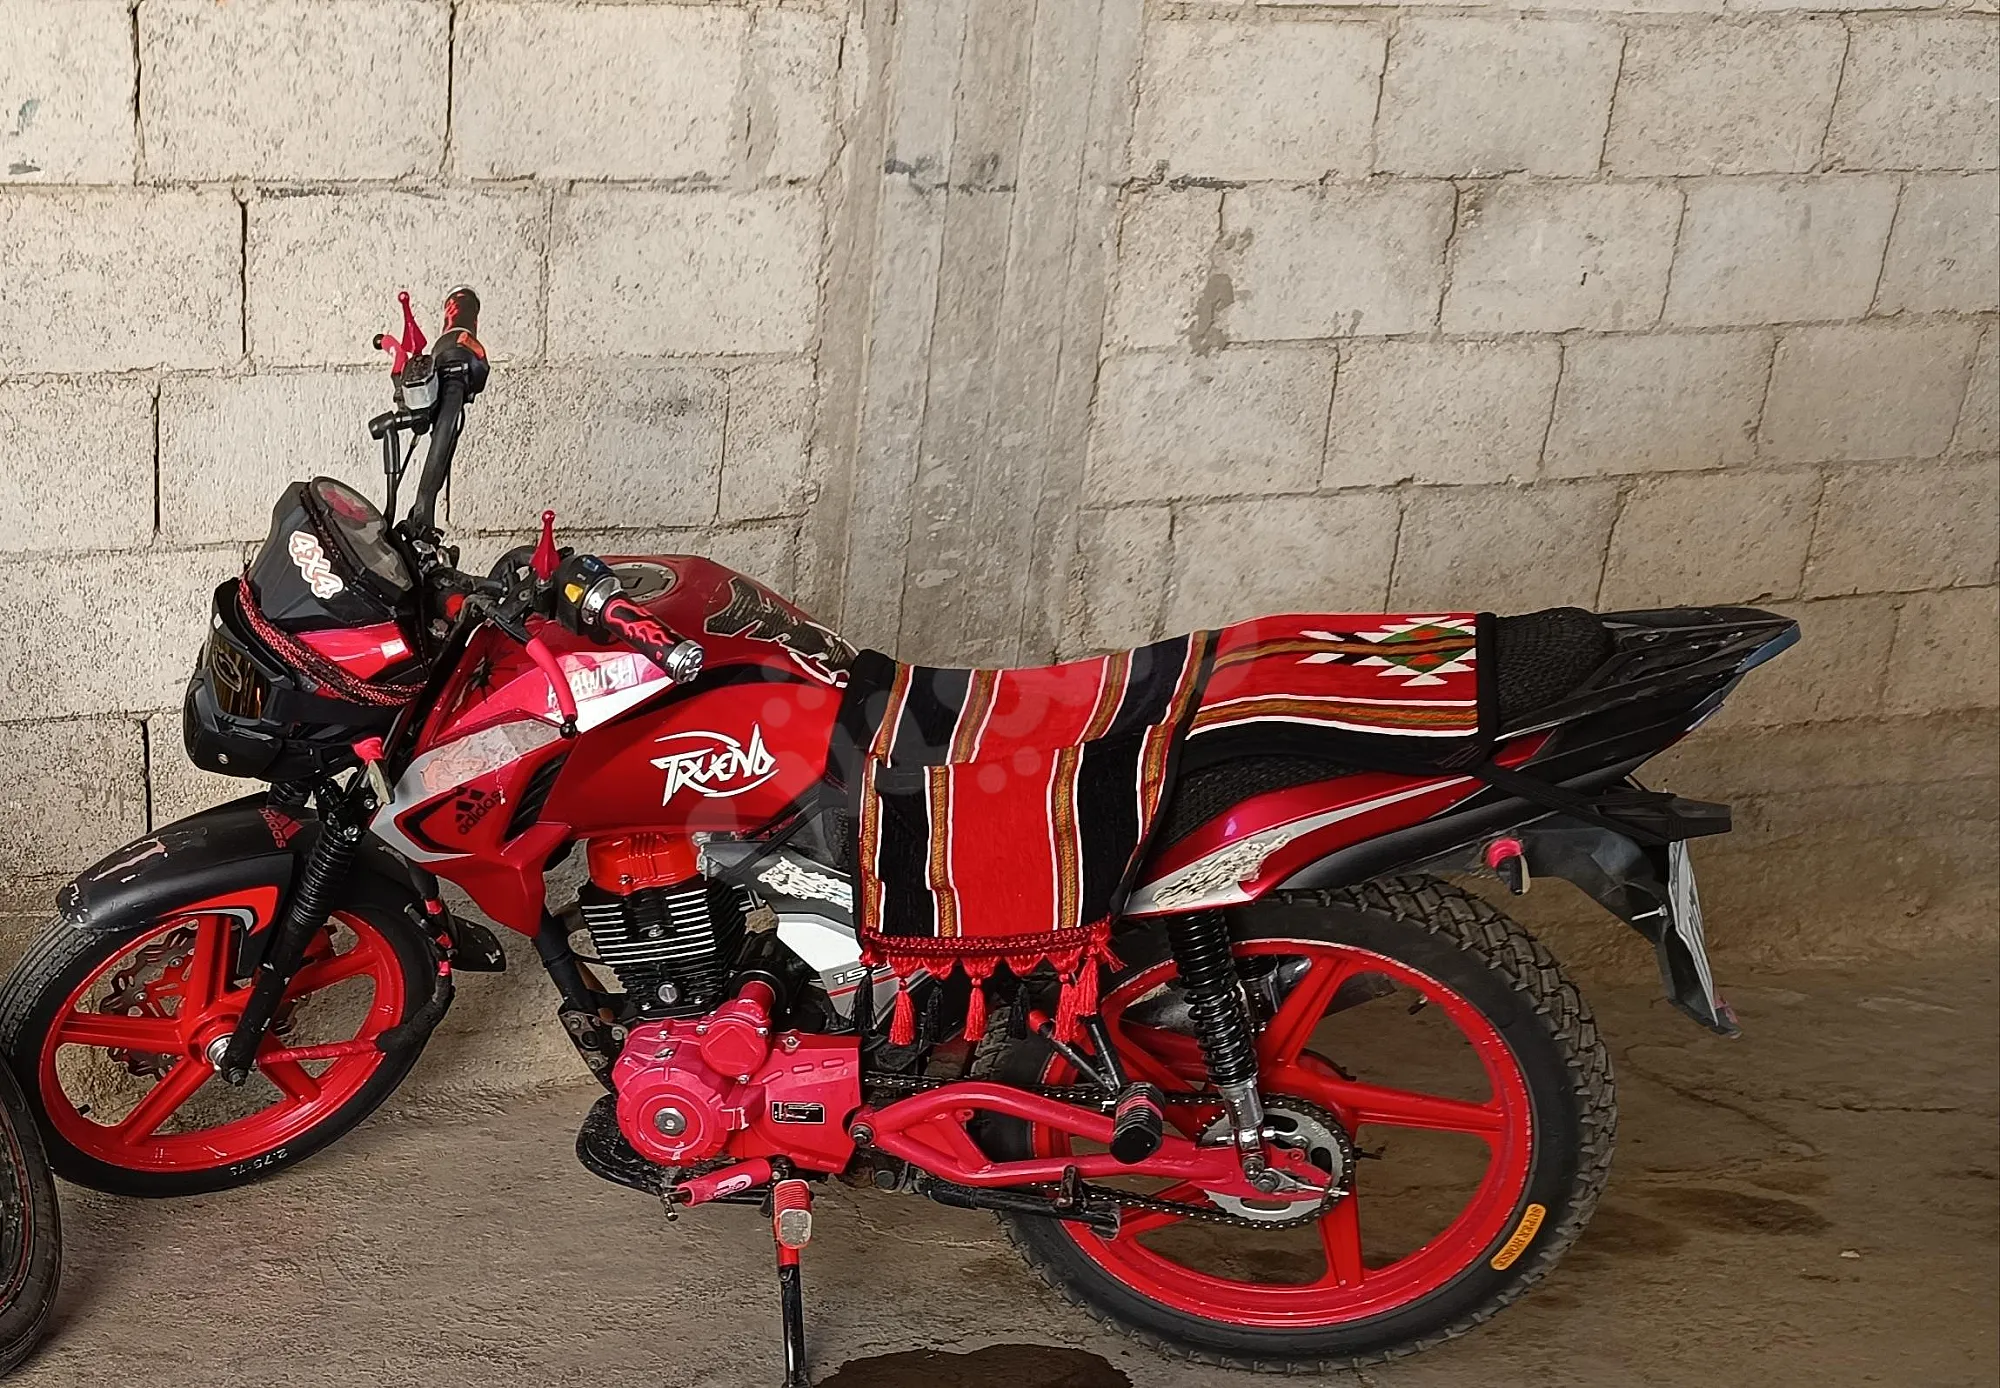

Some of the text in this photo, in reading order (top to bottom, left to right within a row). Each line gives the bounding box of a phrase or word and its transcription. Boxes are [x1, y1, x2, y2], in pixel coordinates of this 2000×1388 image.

[650, 722, 777, 806] TRUENO
[258, 807, 287, 849] adidas
[457, 790, 504, 836] adidas
[832, 962, 893, 986] 15
[1516, 1205, 1542, 1238] SUPER
